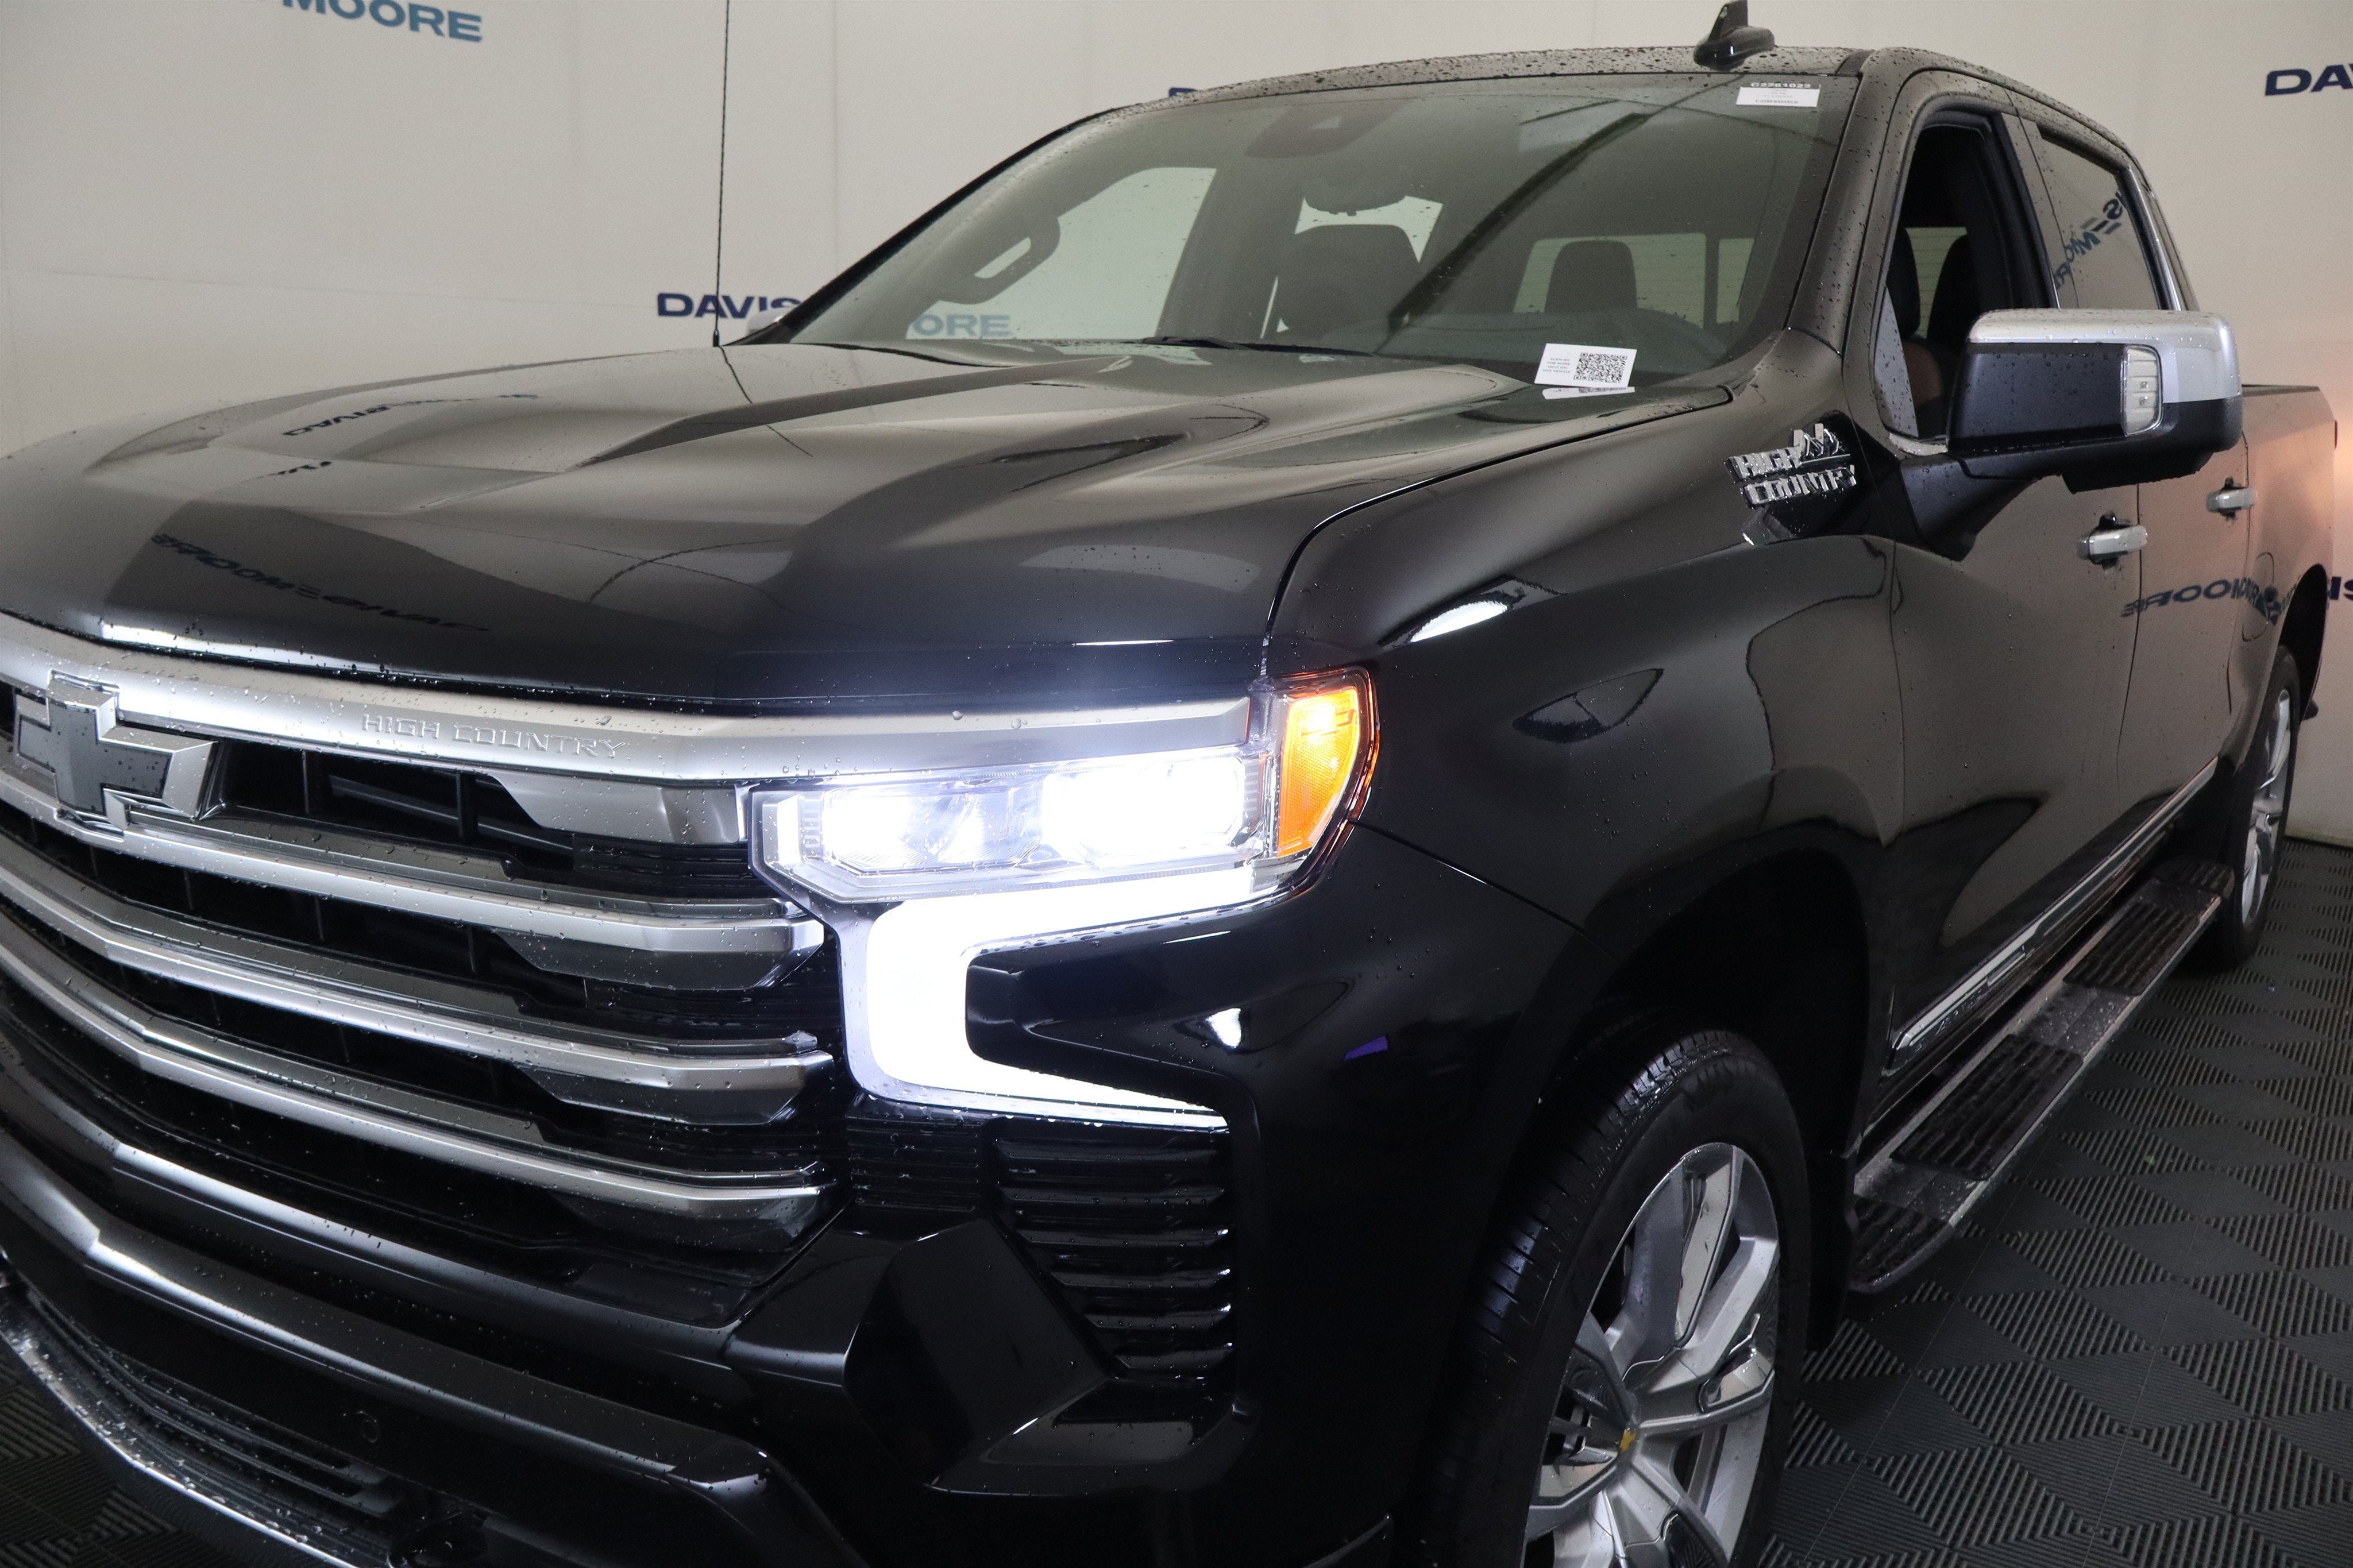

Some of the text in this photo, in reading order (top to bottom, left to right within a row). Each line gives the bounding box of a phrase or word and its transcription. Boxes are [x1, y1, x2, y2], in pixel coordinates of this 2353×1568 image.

[2265, 64, 2353, 96] DA
[1729, 446, 1803, 480] HIGH
[1743, 465, 1857, 505] COUNTRY
[362, 714, 626, 758] HIGH COUNTRY
